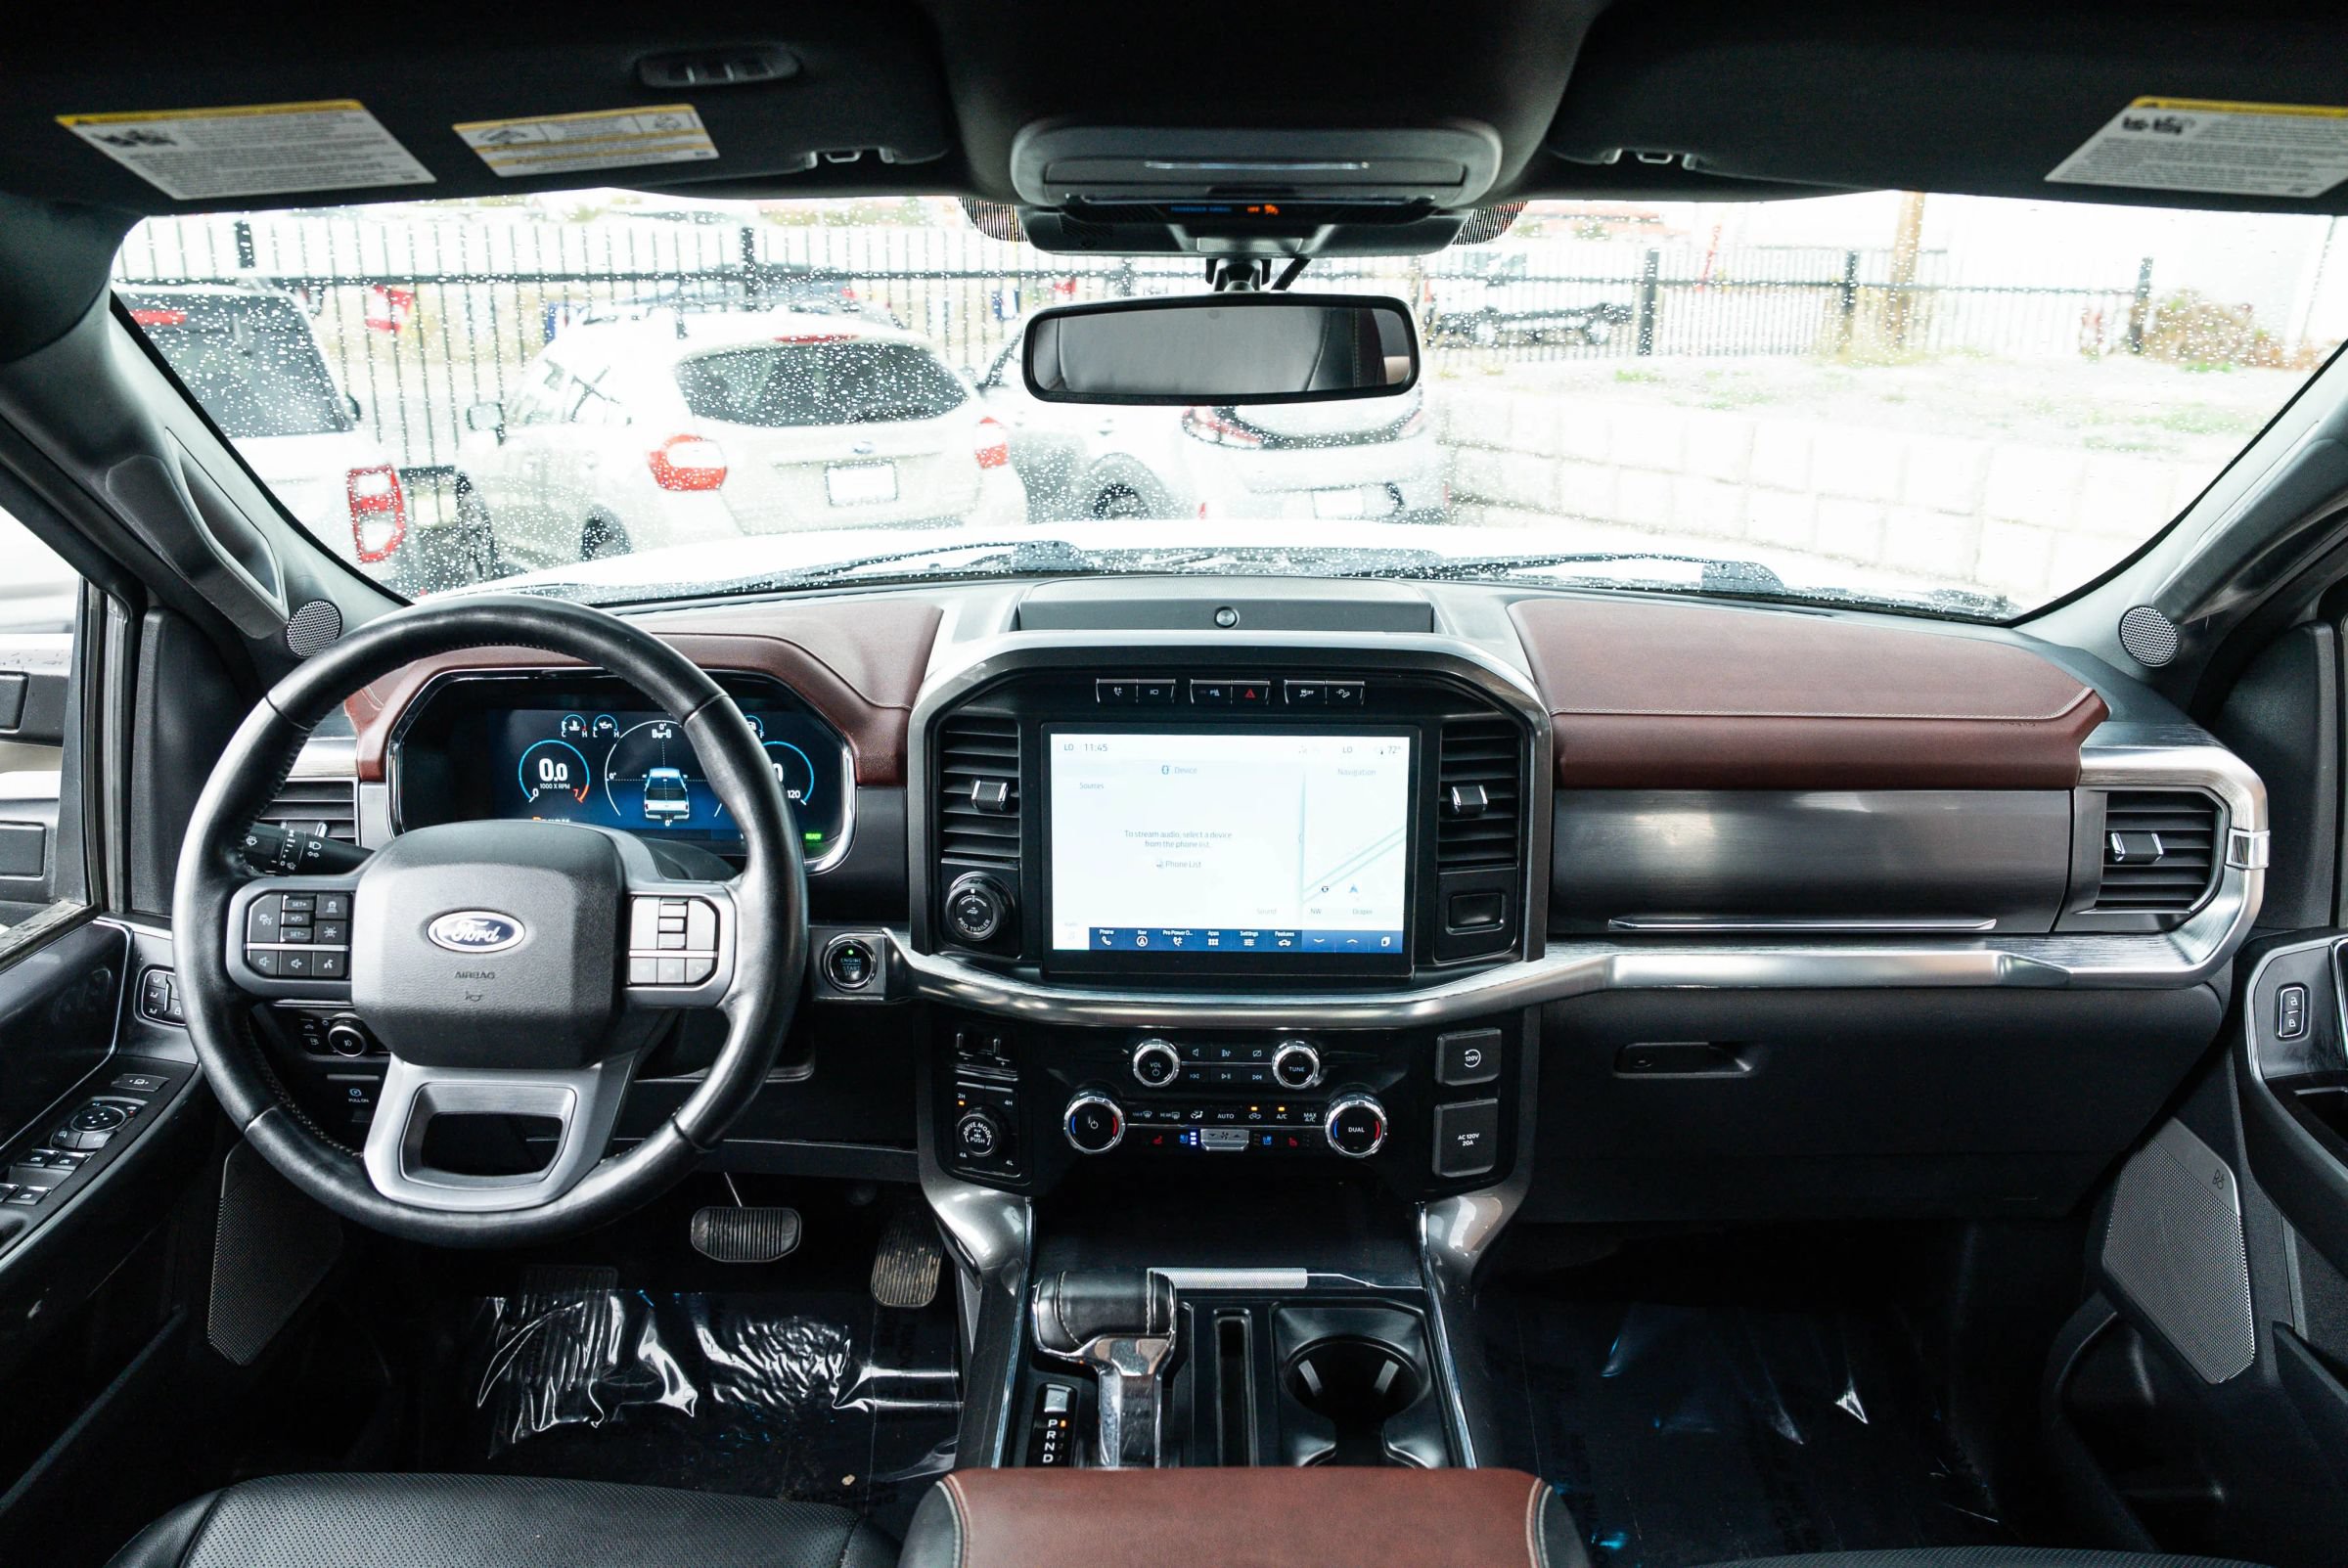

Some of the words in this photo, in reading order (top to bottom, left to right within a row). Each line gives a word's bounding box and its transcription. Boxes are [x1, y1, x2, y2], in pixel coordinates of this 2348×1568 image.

[539, 758, 567, 782] 0.0
[1337, 768, 1377, 777] Navigation
[1175, 840, 1197, 849] phone
[1165, 860, 1188, 869] Phone
[1189, 860, 1201, 869] List
[958, 917, 969, 929] PRO
[970, 918, 991, 932] TRAILER
[451, 919, 501, 943] Ford
[454, 971, 495, 980] AIRBAG
[963, 1122, 976, 1136] DRIVE
[977, 1123, 992, 1140] MODE
[1048, 1418, 1058, 1428] P
[1046, 1430, 1057, 1440] R
[1044, 1442, 1056, 1452] N
[1042, 1454, 1054, 1463] D
